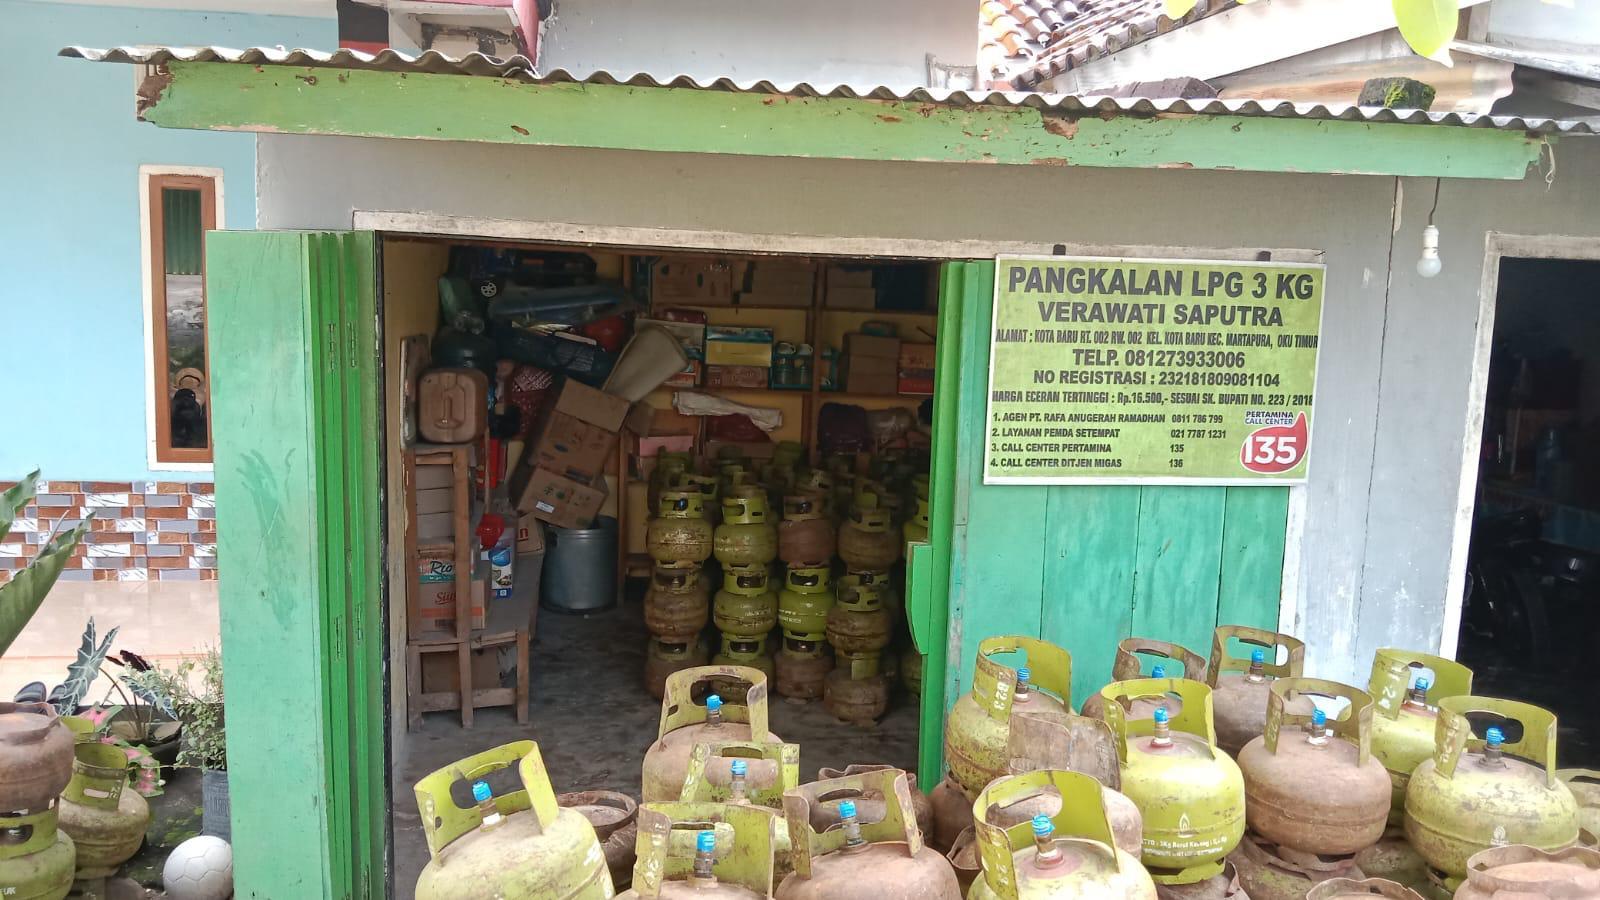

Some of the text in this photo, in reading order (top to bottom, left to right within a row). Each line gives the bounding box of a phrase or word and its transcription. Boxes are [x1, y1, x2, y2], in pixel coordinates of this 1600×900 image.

[1008, 266, 1314, 300] PANGKALAN LPG 3 KG
[1037, 301, 1284, 327] VERAWATI SAPUTRA
[996, 328, 1028, 343] ALAMAT
[1034, 329, 1055, 344] KOTA
[1056, 329, 1078, 344] BARU
[1079, 329, 1091, 344] RT.
[1094, 330, 1109, 344] 002
[1110, 330, 1125, 344] RW.
[1127, 331, 1142, 345] 002
[1146, 331, 1162, 345] KEL.
[1164, 331, 1184, 345] KOTA
[1185, 332, 1205, 346] BARU
[1207, 332, 1224, 346] KEC.
[1225, 333, 1273, 349] MARTAPURA,
[1277, 334, 1293, 348] OKU
[1295, 334, 1319, 349] TIMUR
[1072, 349, 1246, 368] TELP. 081273933006
[1033, 370, 1055, 384] NO
[1059, 370, 1147, 385] REGISTRASI
[1158, 371, 1280, 387] 232181809081104
[992, 390, 1023, 403] HARGA
[1025, 390, 1060, 403] ECERAN
[1062, 391, 1109, 404] TERTINGGI
[1170, 392, 1200, 405] SESUAI
[1202, 392, 1216, 405] SK.
[1218, 393, 1248, 405] BUPATI
[1250, 393, 1266, 406] NO.
[1268, 394, 1285, 406] 223
[993, 412, 1224, 424] 1. AGEN PT. RAFA ANUGERAH RAMADHAN 0811 786 799
[1245, 410, 1294, 419] PERTAMINA
[992, 428, 1000, 437] 2.
[1002, 428, 1042, 437] LAYANAN
[1043, 428, 1074, 437] PEMDA
[1075, 428, 1121, 438] SETEMPAT
[1170, 429, 1185, 438] 021
[1207, 429, 1226, 438] 1231
[991, 443, 1184, 453] 3. CALL CENTER PERTAMINA 135
[1244, 435, 1297, 464] 135
[990, 458, 998, 467] 4.
[1000, 458, 1023, 467] CALL
[1025, 458, 1059, 467] CENTER
[1061, 458, 1093, 468] DITJEN
[1094, 459, 1122, 468] MIGAS
[430, 560, 453, 575] Rio
